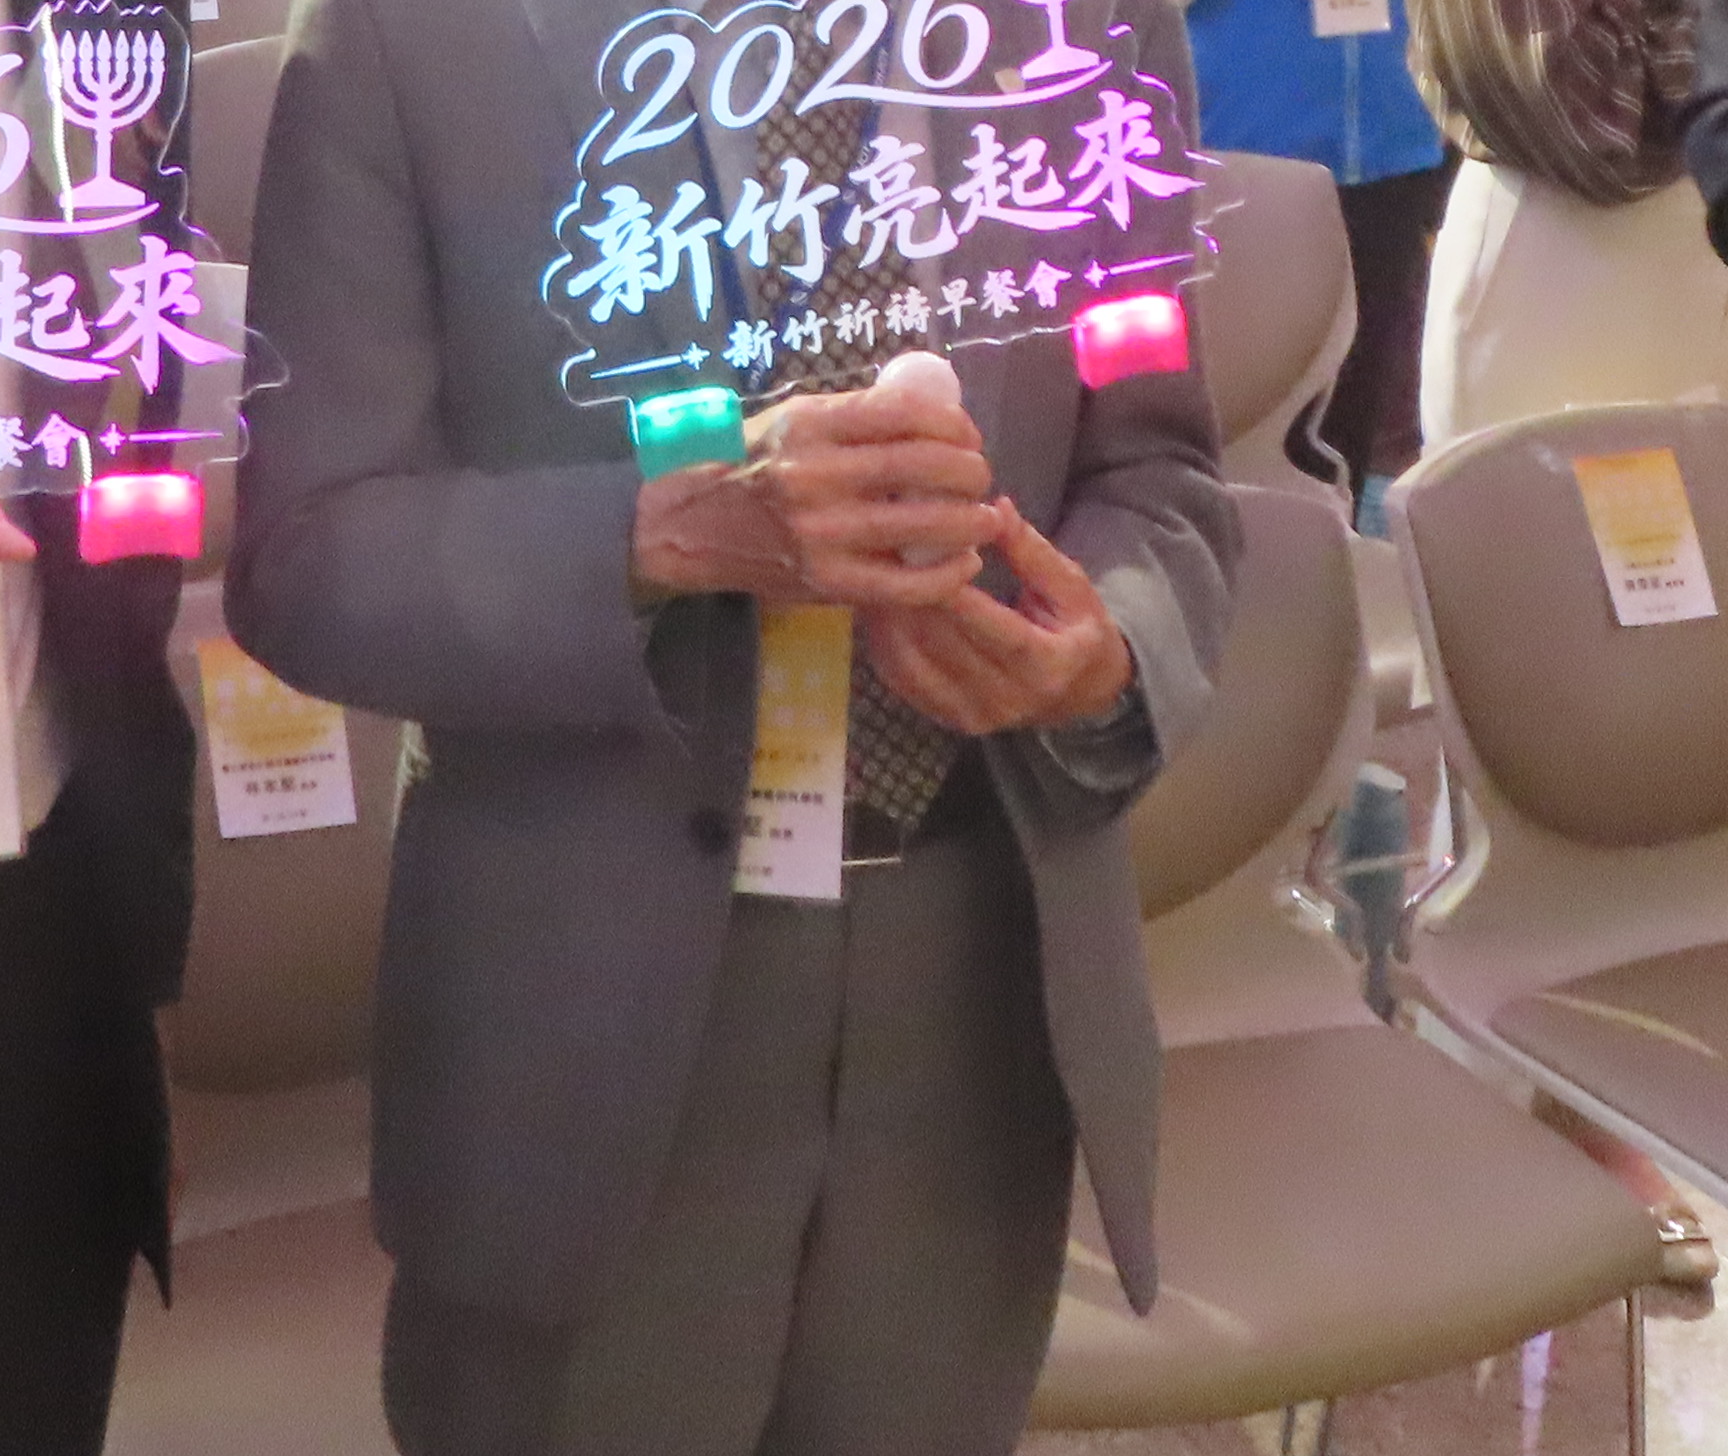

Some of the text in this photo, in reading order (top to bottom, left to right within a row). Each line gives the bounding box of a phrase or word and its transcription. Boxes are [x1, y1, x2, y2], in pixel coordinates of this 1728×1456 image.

[566, 90, 1205, 324] 新竹亮起來
[722, 259, 1072, 371] 新竹祈禱早餐會
